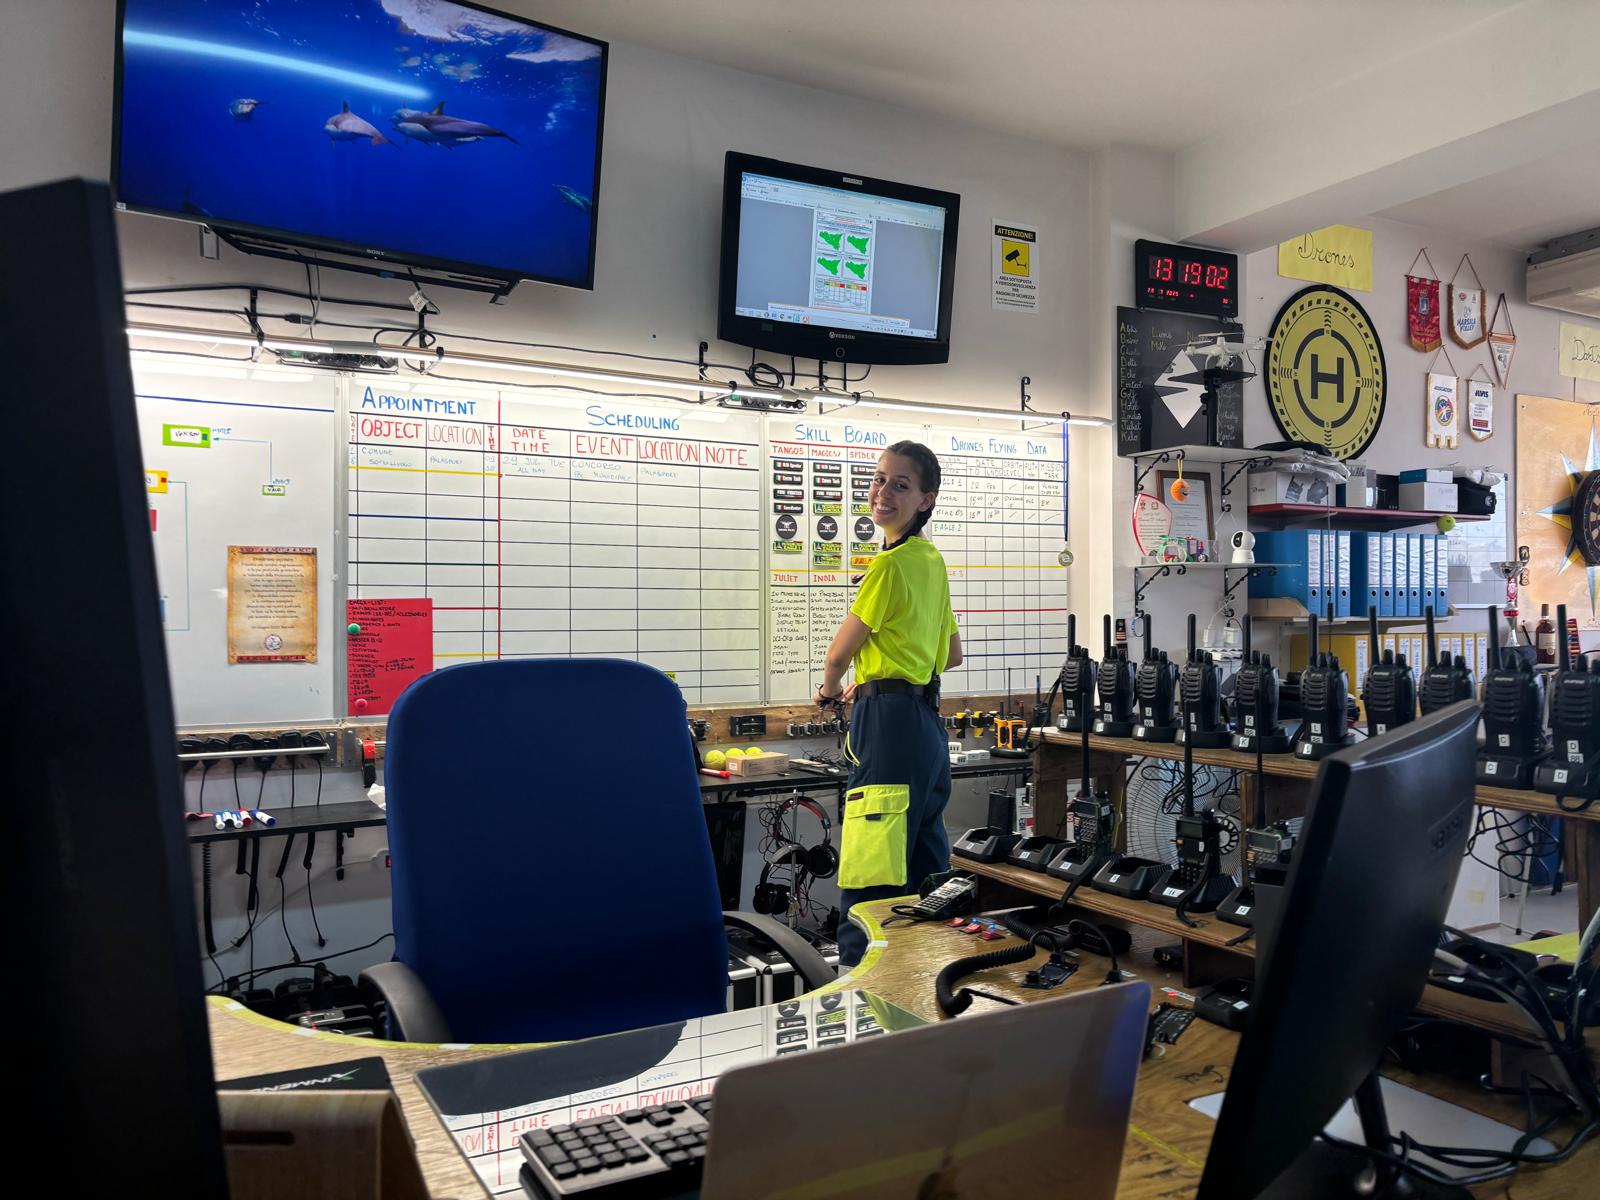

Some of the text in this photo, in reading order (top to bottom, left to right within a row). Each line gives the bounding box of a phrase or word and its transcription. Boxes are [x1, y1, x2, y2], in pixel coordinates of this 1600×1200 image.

[1298, 232, 1355, 269] Drones
[1156, 257, 1229, 289] 13 19 02
[1310, 353, 1344, 404] H
[361, 418, 423, 439] OBJECT
[427, 423, 482, 446] LOCATION
[487, 425, 495, 450] TIME
[512, 428, 547, 440] DATE
[794, 423, 887, 446] SKILL BOARD
[511, 441, 550, 453] TIME
[576, 435, 634, 456] EVENT
[638, 439, 699, 463] LOCATION
[705, 445, 748, 466] NOTE
[813, 574, 837, 583] INDIA
